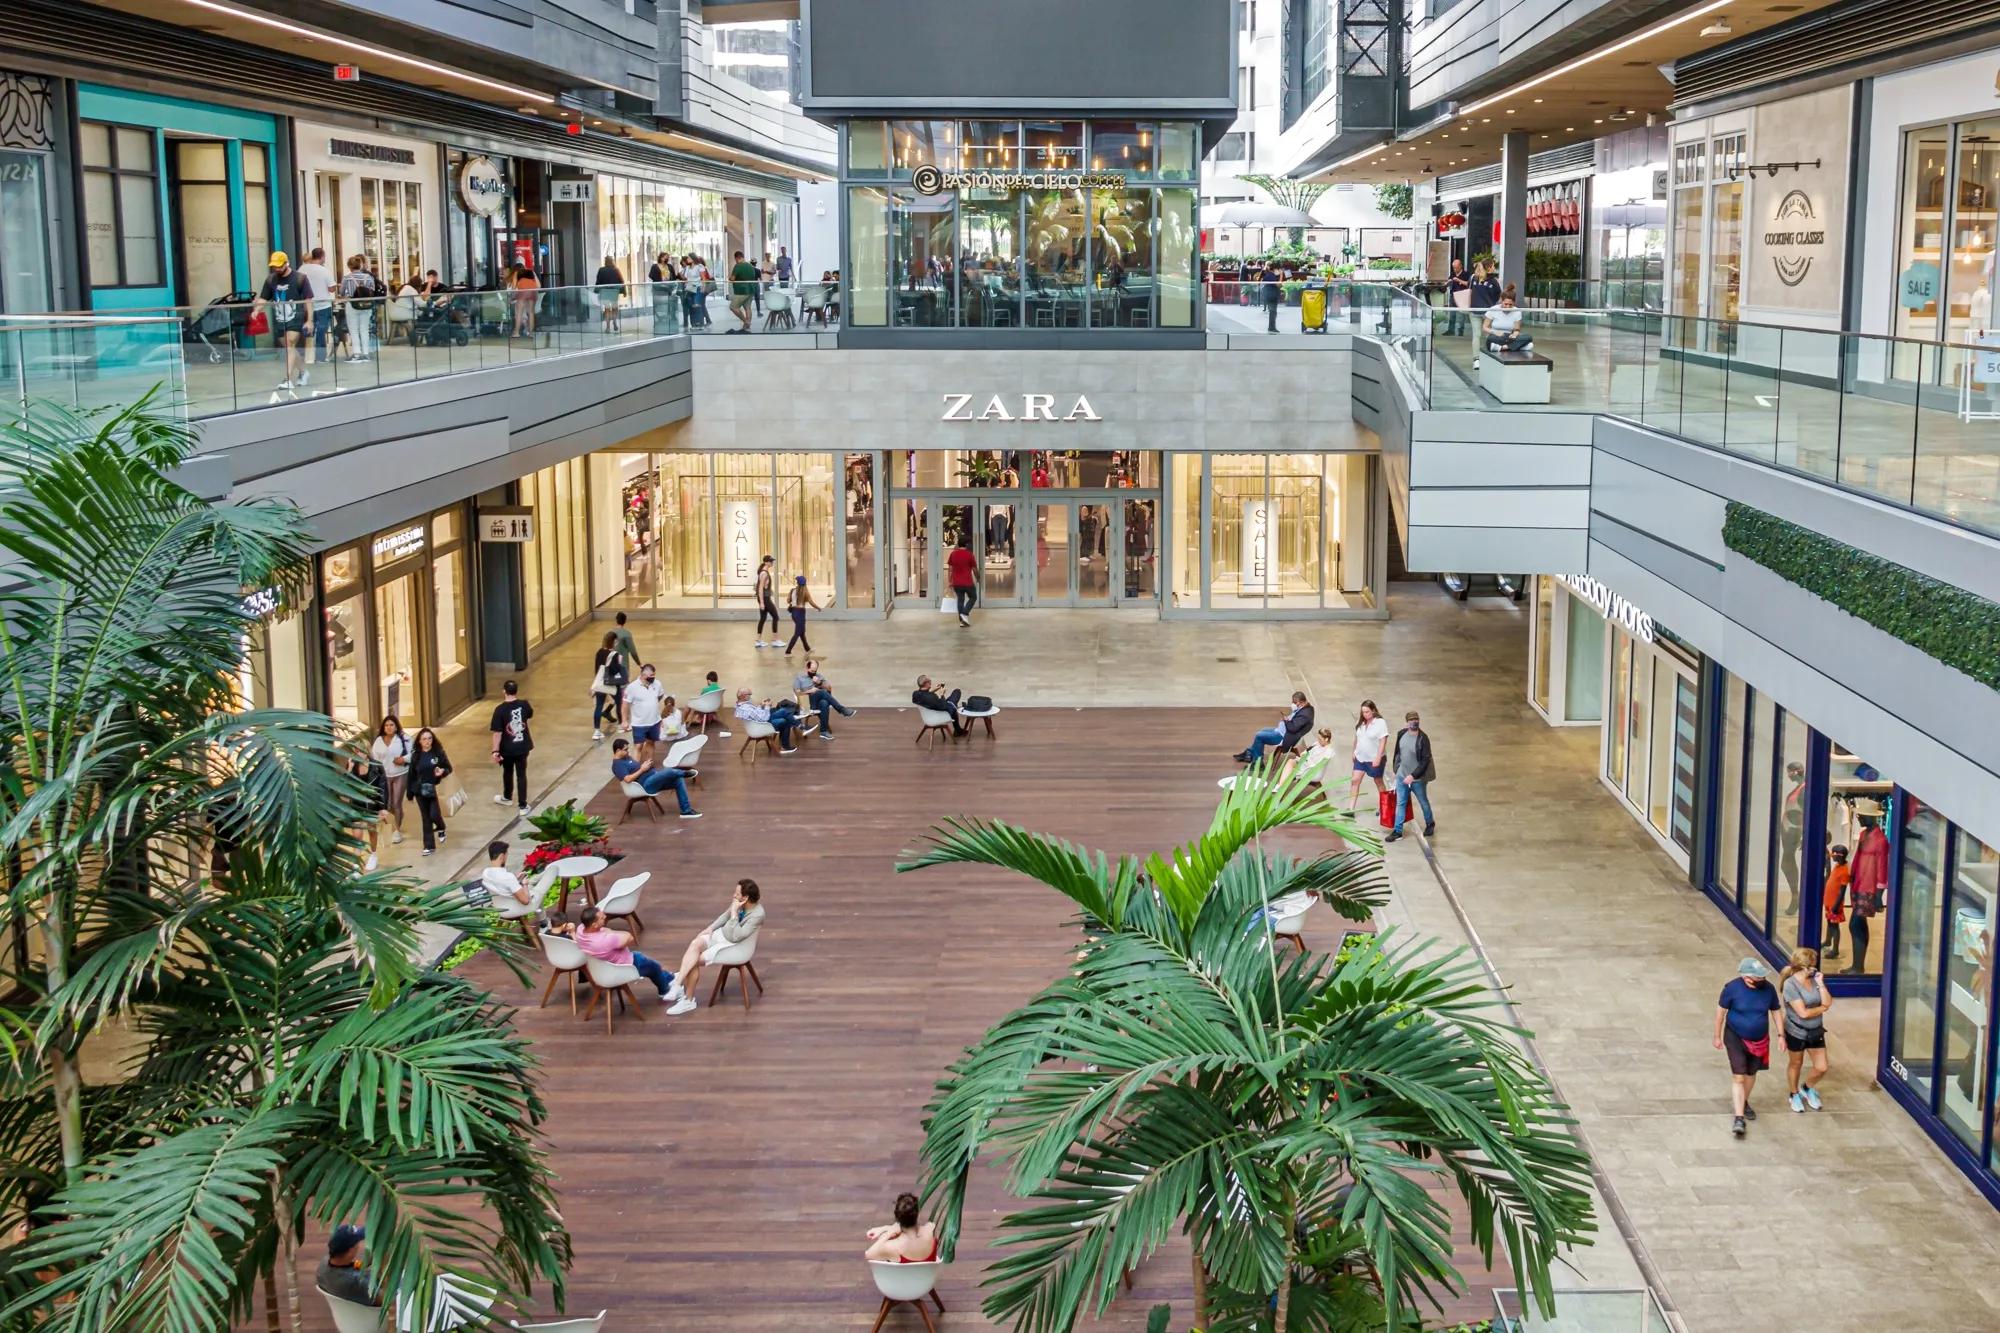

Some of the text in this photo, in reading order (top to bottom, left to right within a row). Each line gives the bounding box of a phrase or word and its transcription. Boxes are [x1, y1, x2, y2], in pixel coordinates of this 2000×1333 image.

[1031, 174, 1081, 189] CIELO
[1081, 174, 1125, 186] COFFEE
[1764, 230, 1824, 246] COOKING CLASSES
[1908, 280, 1931, 297] SALE
[942, 393, 1103, 421] ZARA
[735, 510, 748, 578] SALE
[1254, 509, 1266, 577] SALE
